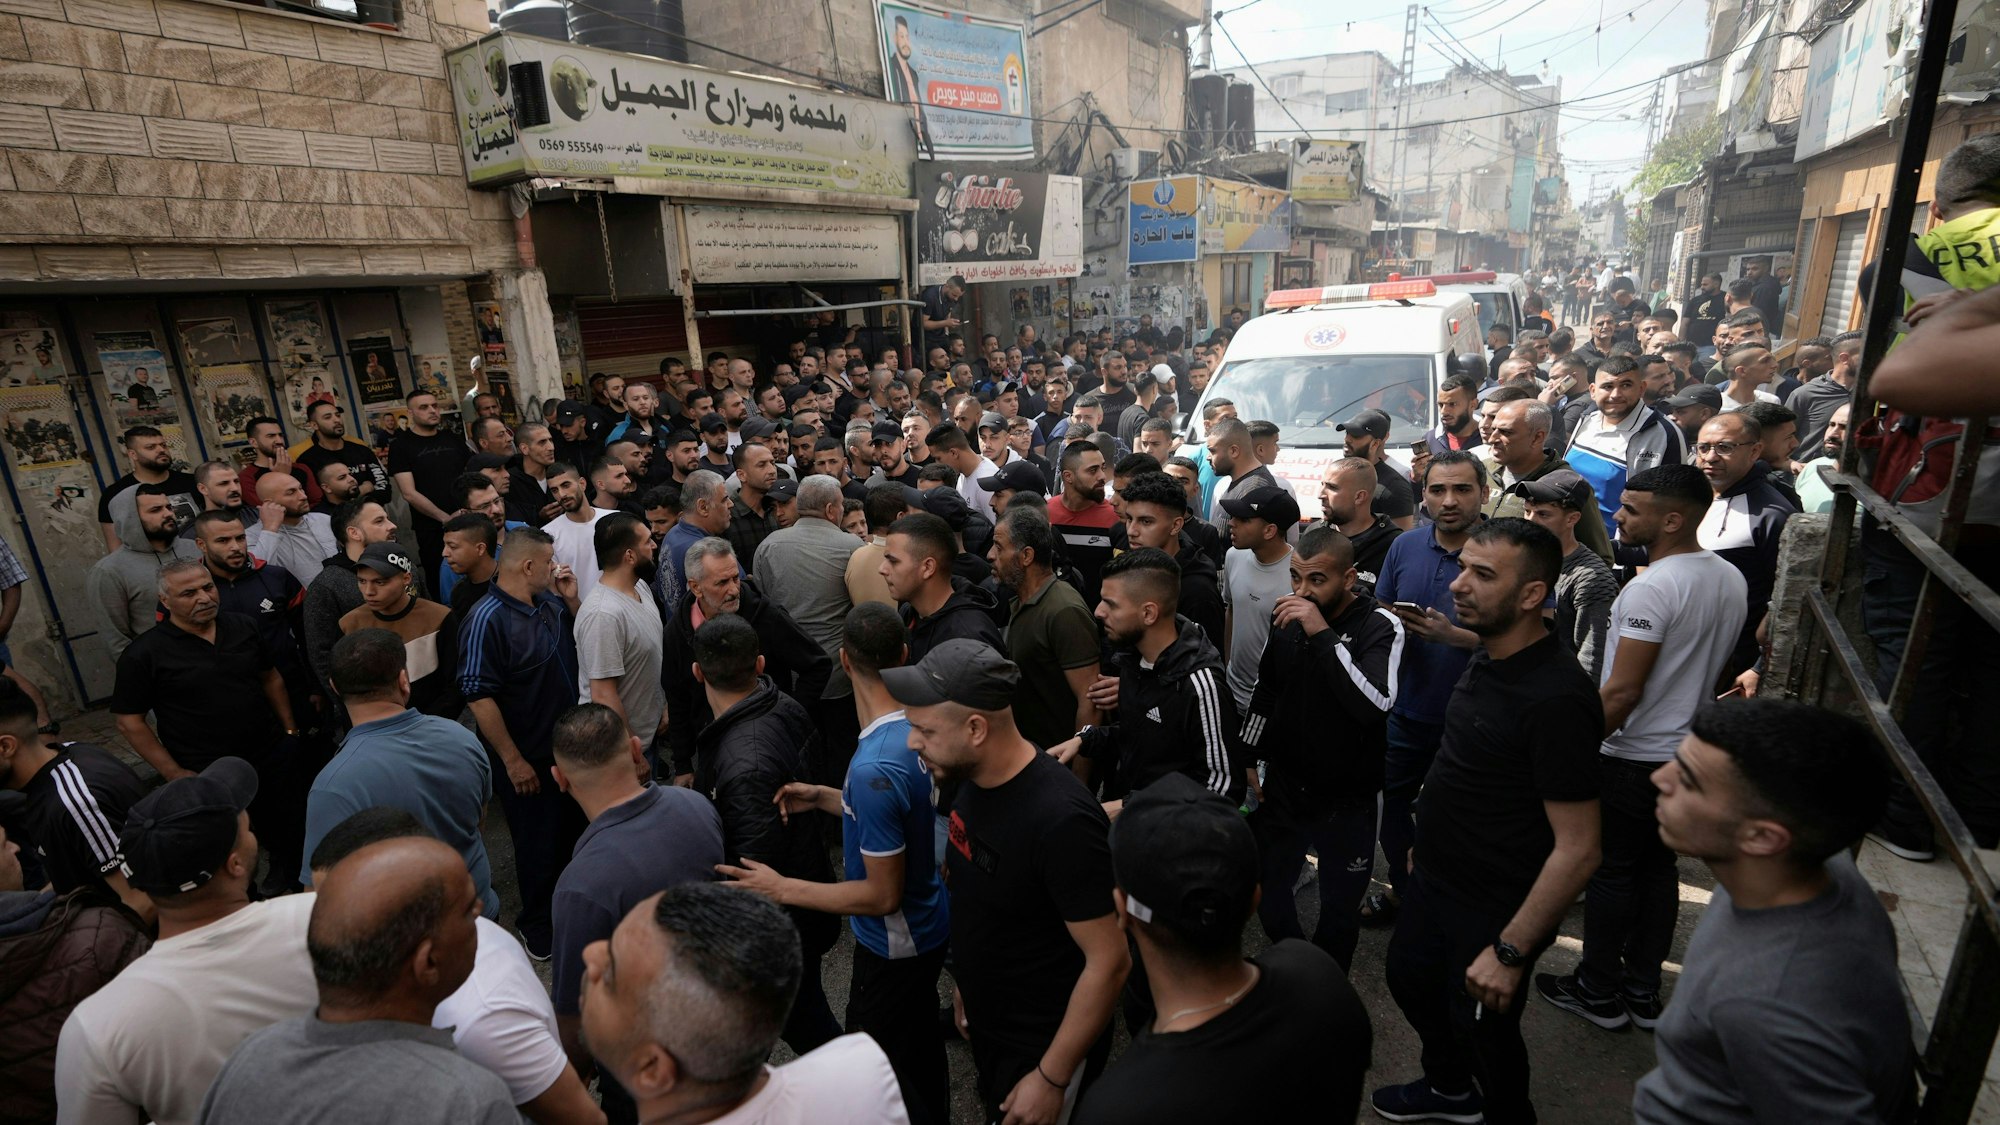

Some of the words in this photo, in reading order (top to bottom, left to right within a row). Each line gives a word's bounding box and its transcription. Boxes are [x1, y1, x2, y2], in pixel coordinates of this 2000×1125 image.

[601, 68, 697, 121] الجميل
[932, 87, 958, 105] عويص
[960, 86, 976, 106] منير
[977, 91, 999, 107] مصعب
[705, 82, 784, 132] ومزارع
[788, 93, 847, 133] ملحمة
[539, 138, 565, 151] 0569
[567, 140, 604, 154] 555549
[625, 142, 643, 155] شاهر
[542, 157, 567, 170] 0569
[1171, 226, 1194, 244] باب
[1628, 617, 1651, 628] KARL
